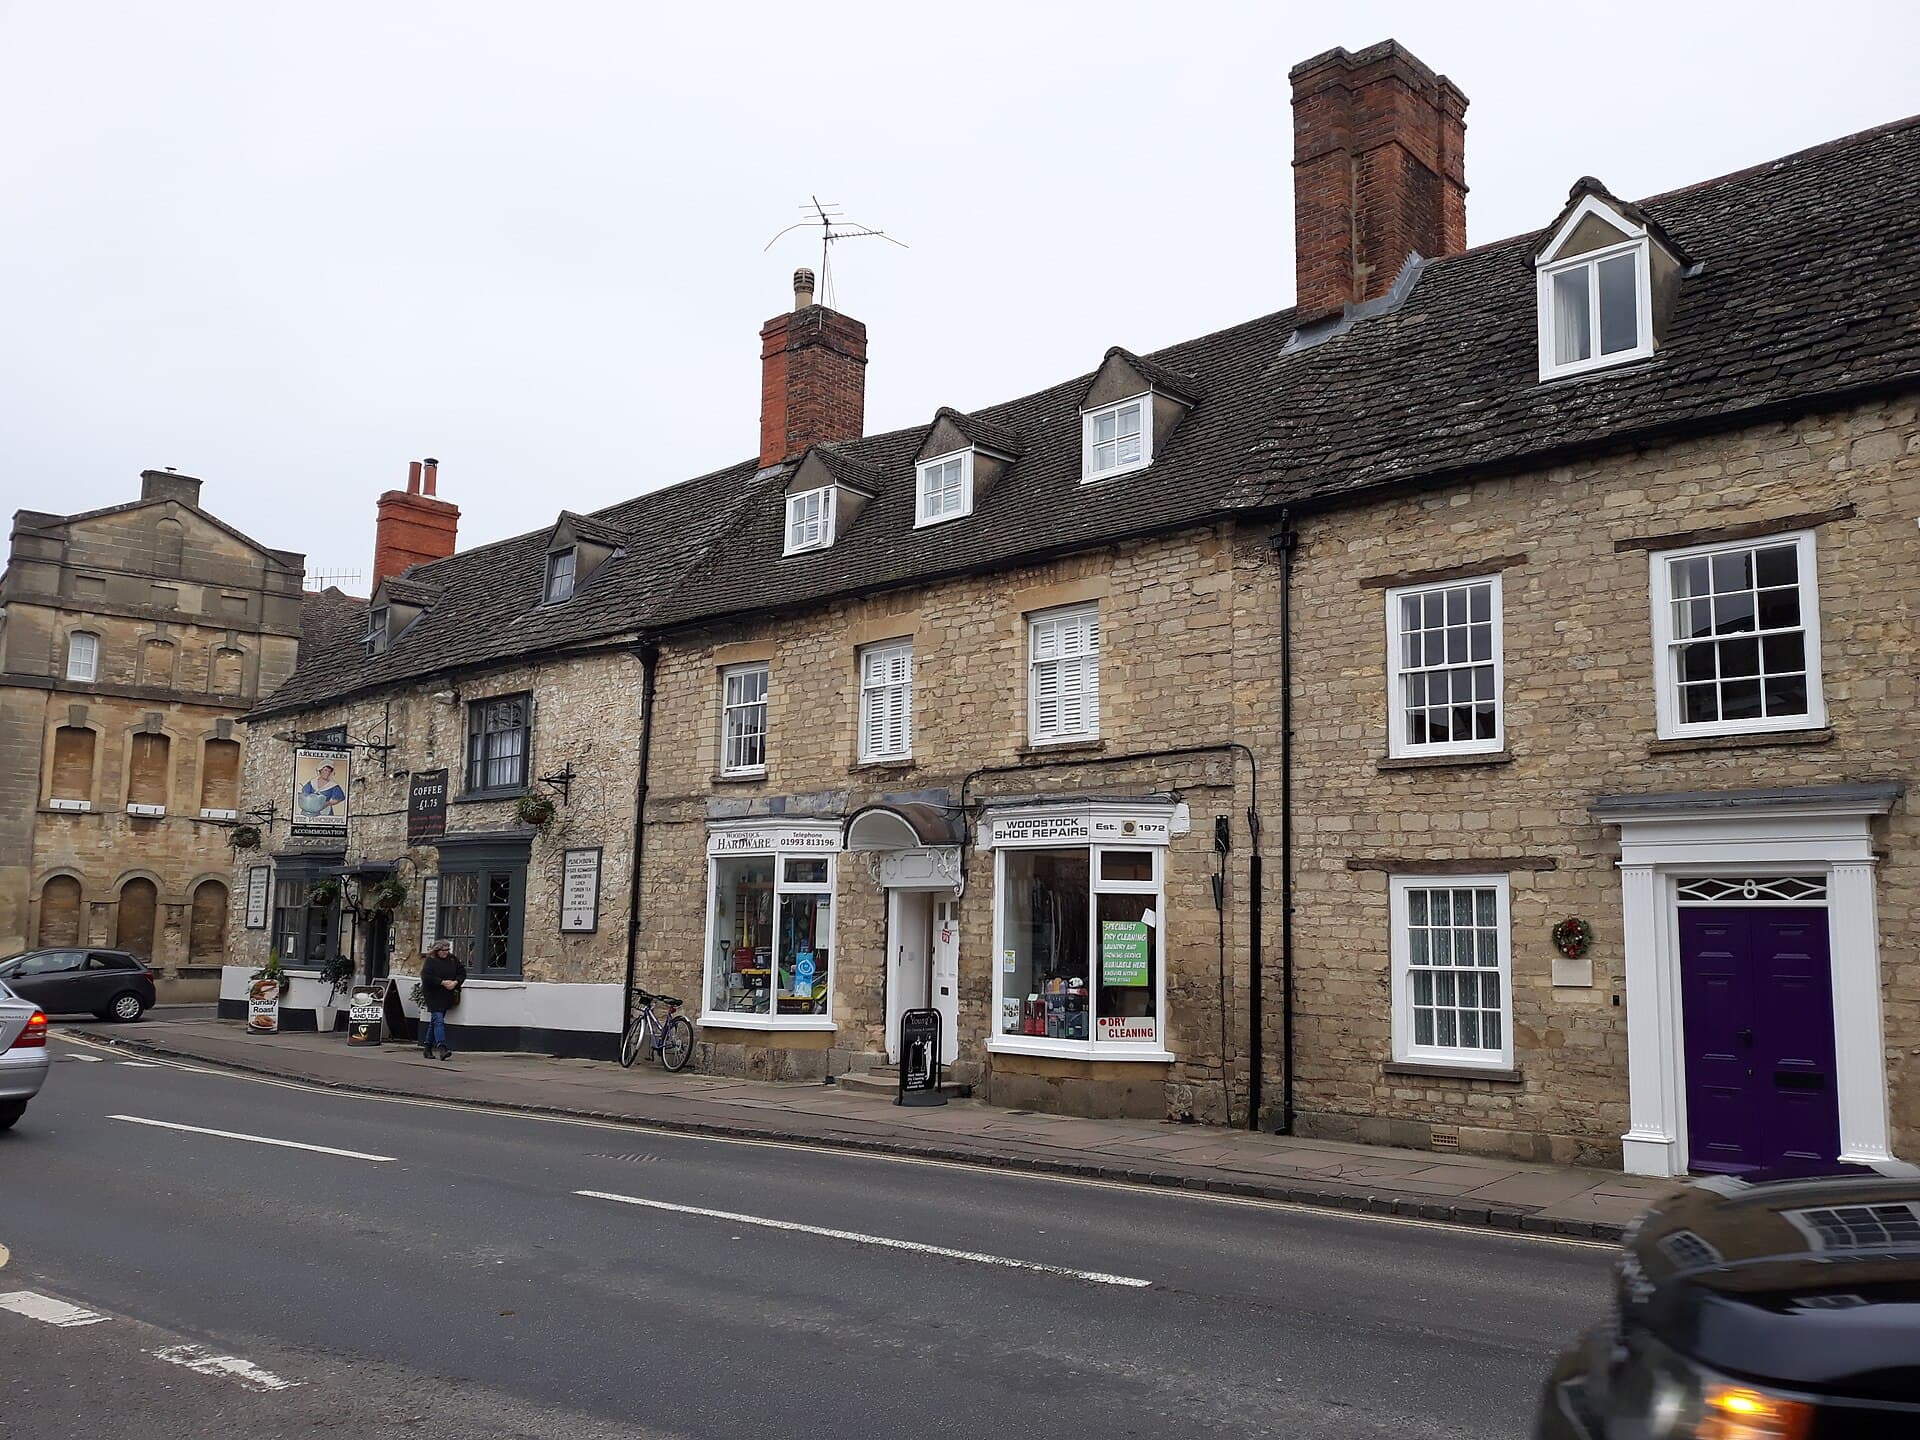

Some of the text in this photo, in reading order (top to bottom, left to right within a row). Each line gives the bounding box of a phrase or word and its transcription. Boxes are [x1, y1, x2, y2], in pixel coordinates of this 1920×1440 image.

[298, 750, 329, 758] ARKELL'S
[413, 785, 443, 796] COFFEE
[418, 799, 438, 811] £1.75
[1006, 817, 1079, 829] WOODSTOCK
[1095, 823, 1166, 832] Est. 1972
[293, 828, 345, 836] ACCOMMODATION
[994, 827, 1088, 840] SHOE REPAIRS
[780, 838, 835, 847] 01993 813196
[1104, 922, 1137, 931] SPECIALIST
[1104, 933, 1147, 942] DRY CLEANING
[250, 998, 277, 1007] Sunday
[1108, 1017, 1127, 1027] DRY
[1108, 1028, 1153, 1038] CLEANING
